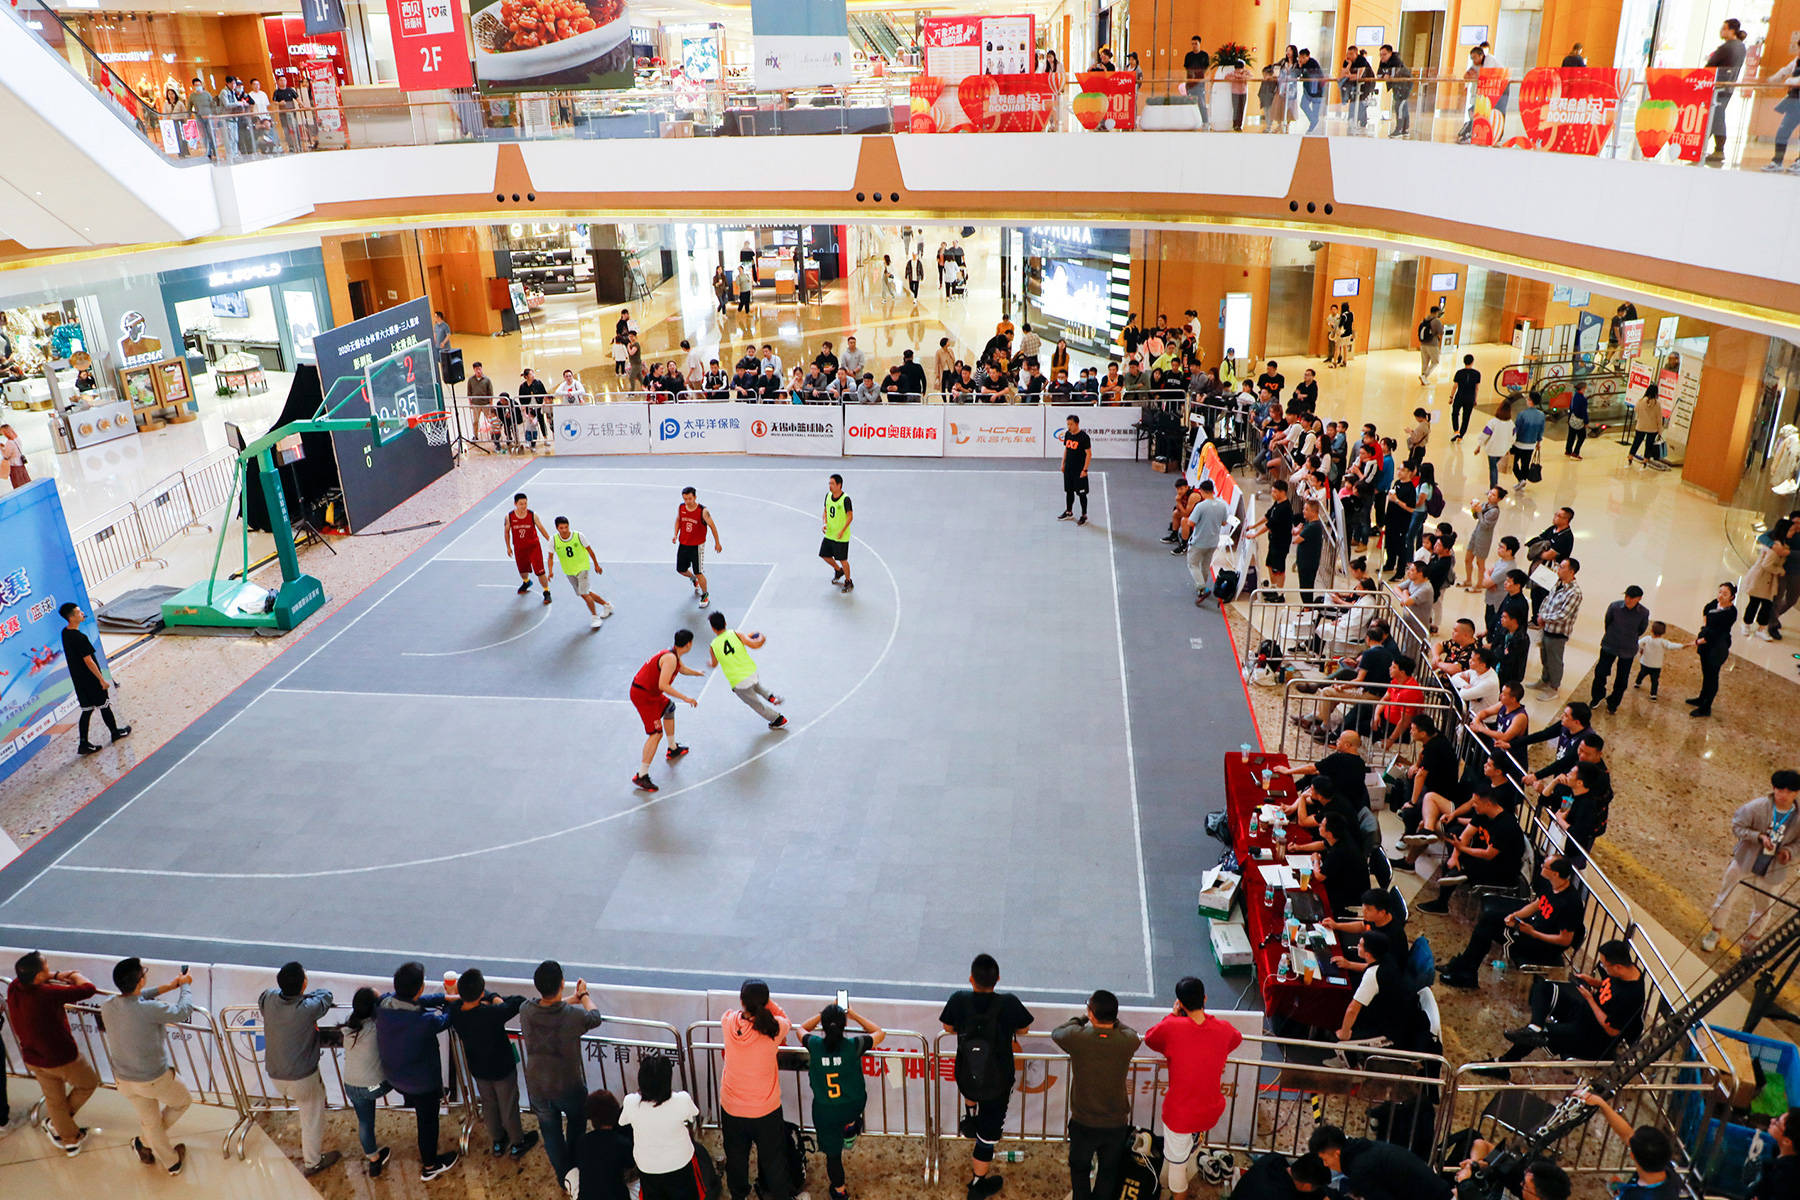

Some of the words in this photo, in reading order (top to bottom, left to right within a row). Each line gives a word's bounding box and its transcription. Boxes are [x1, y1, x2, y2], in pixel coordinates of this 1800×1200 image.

[420, 46, 442, 72] 2F
[404, 356, 416, 383] 2
[587, 422, 643, 437] 无锡宝诚
[683, 418, 741, 431] 太平洋保险
[770, 421, 834, 434] 无锡市篮球协会
[888, 424, 938, 440] 奥联体育
[829, 506, 836, 519] 9
[518, 528, 526, 538] 7
[566, 546, 574, 558] 8
[724, 640, 735, 656] 4
[826, 1073, 841, 1098] 5
